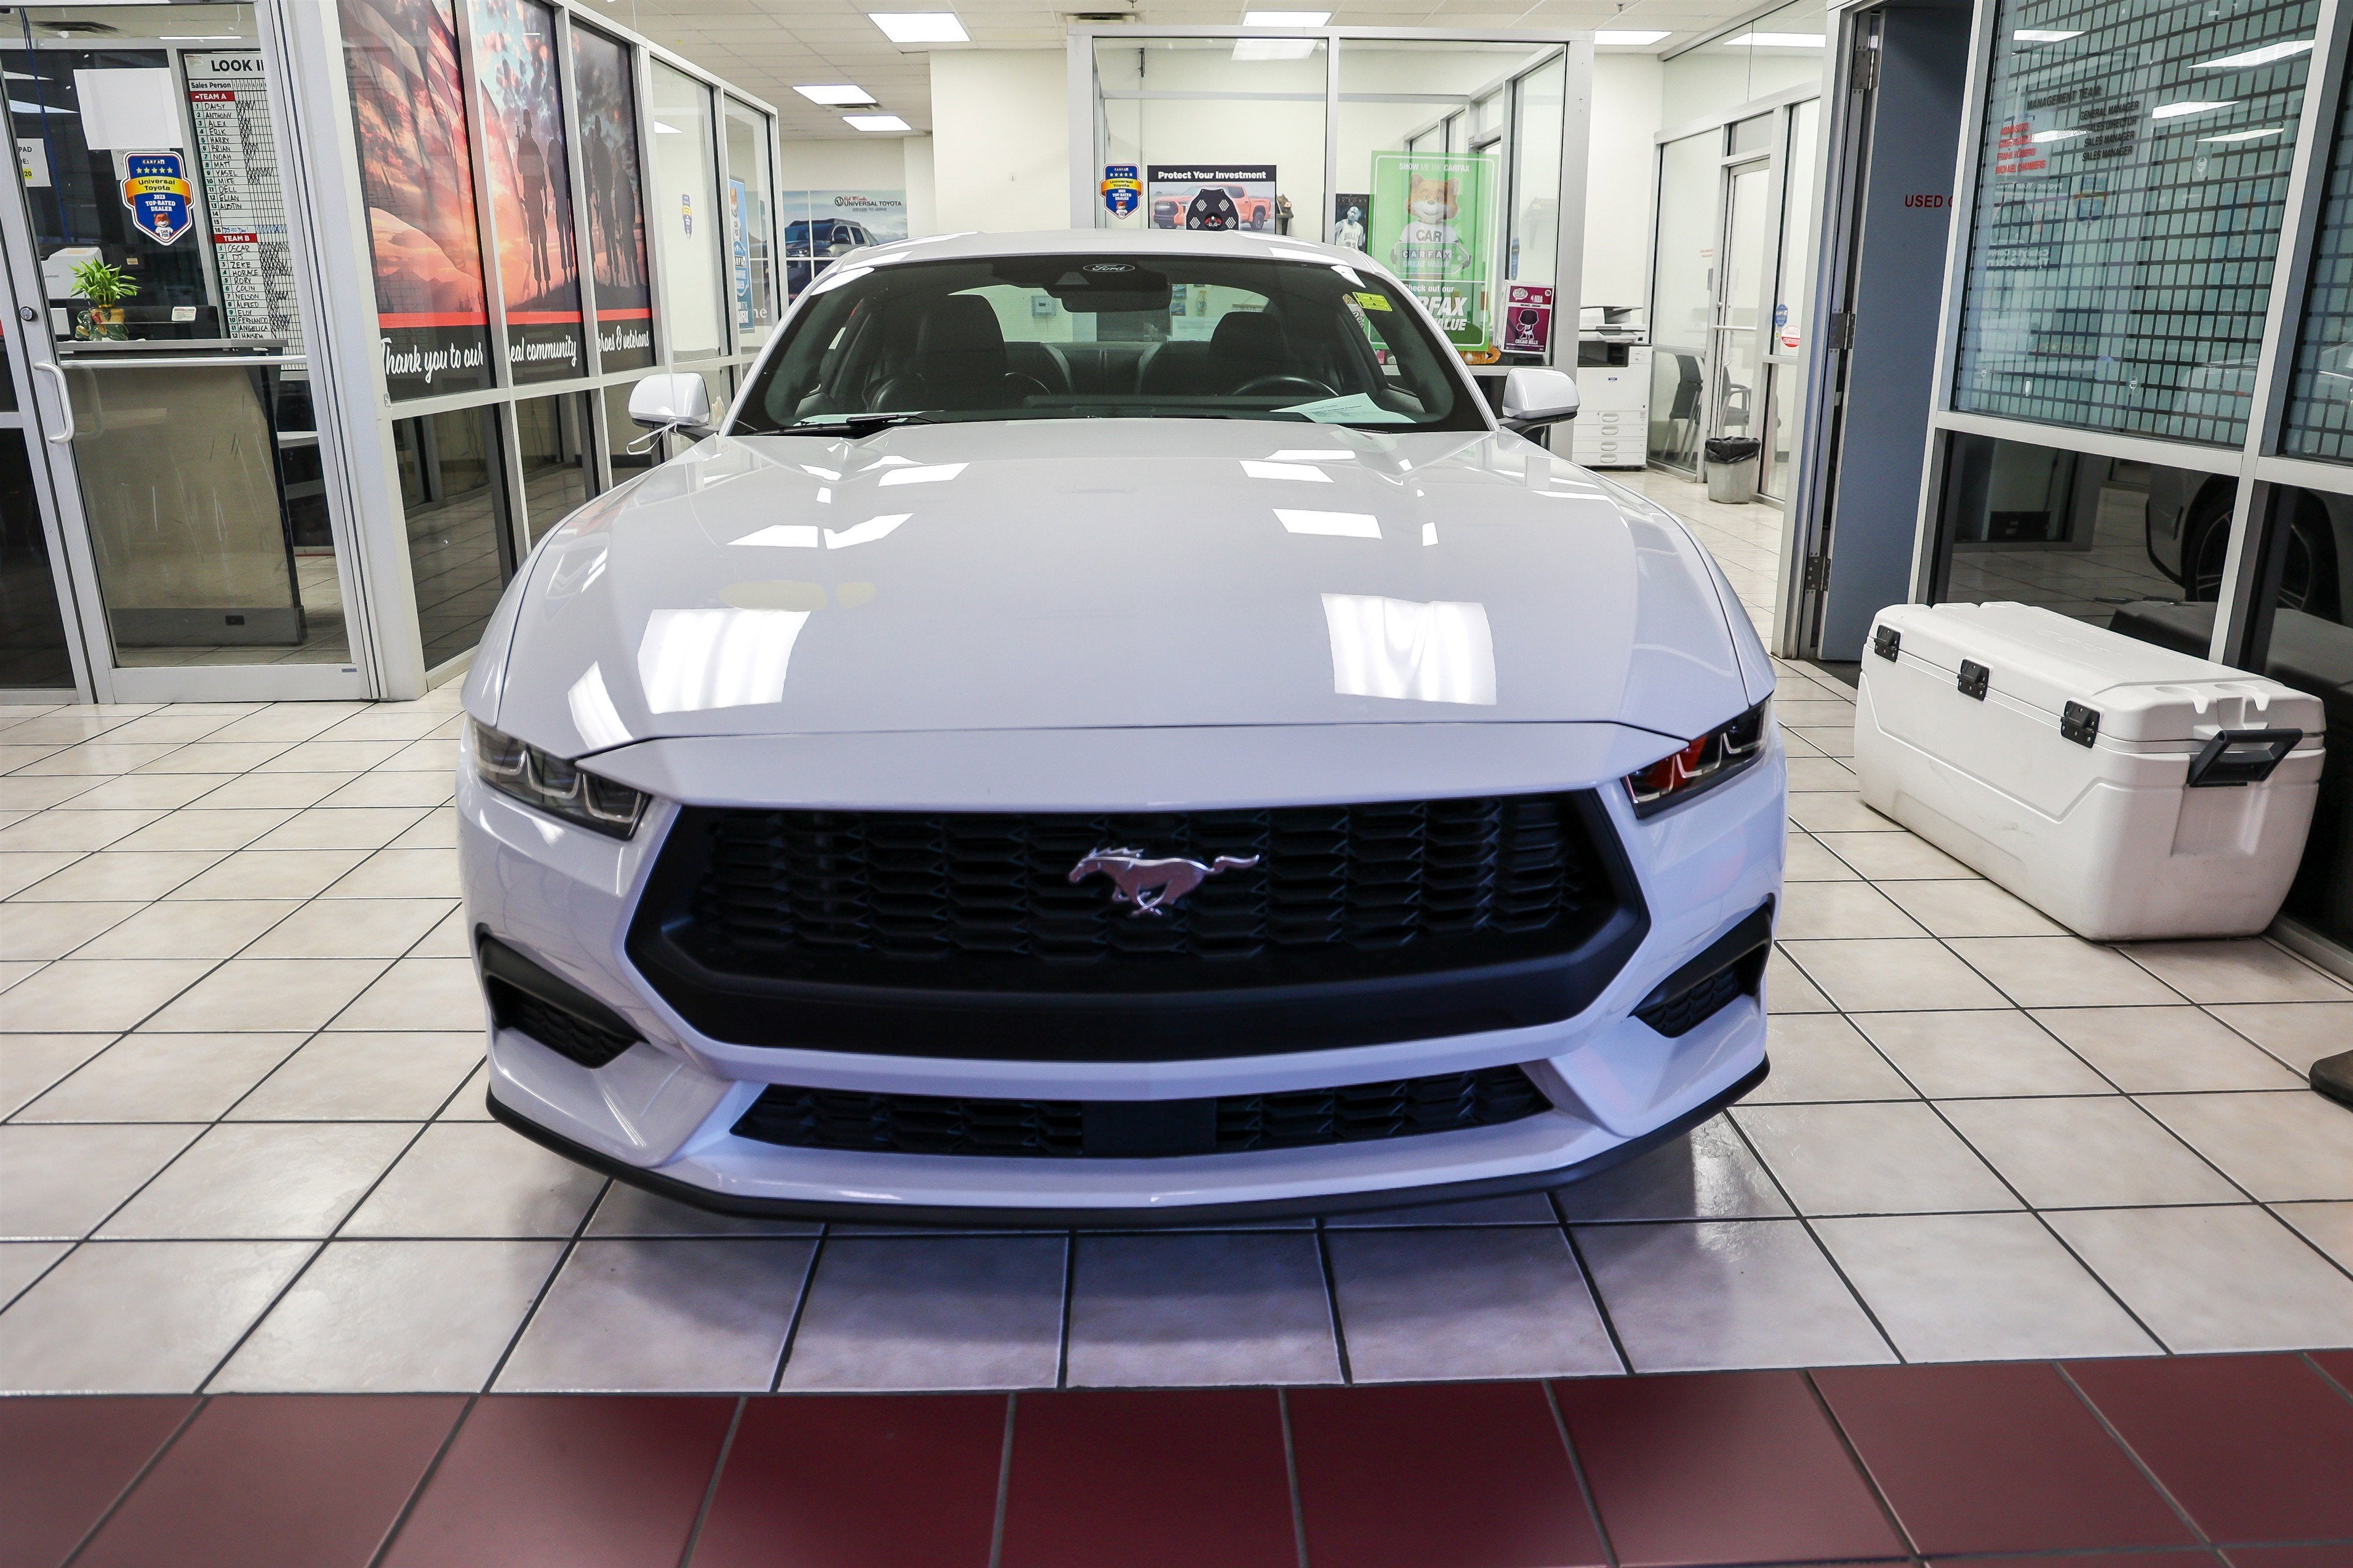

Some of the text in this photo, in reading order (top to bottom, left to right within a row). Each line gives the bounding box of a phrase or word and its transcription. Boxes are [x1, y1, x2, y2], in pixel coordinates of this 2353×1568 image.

[211, 59, 253, 72] LOOK
[2027, 90, 2077, 110] MANAGEMENT
[2080, 110, 2106, 120] GENERAL
[2108, 101, 2139, 114] MANAGER
[2106, 116, 2138, 129] DIRECTOR
[2084, 136, 2106, 148] SALES
[2106, 130, 2135, 144] MANAGER
[2082, 150, 2101, 161] SALES
[2102, 145, 2132, 159] MANAGER
[1399, 163, 1419, 171] SHOW
[1158, 171, 1267, 179] Protect Your Investment
[1904, 195, 1944, 207] USED
[1415, 230, 1442, 242] CAR
[1402, 250, 1452, 258] CARFAX
[623, 329, 650, 349] veterans
[526, 334, 577, 367] community
[380, 337, 484, 383] Thank you to our
